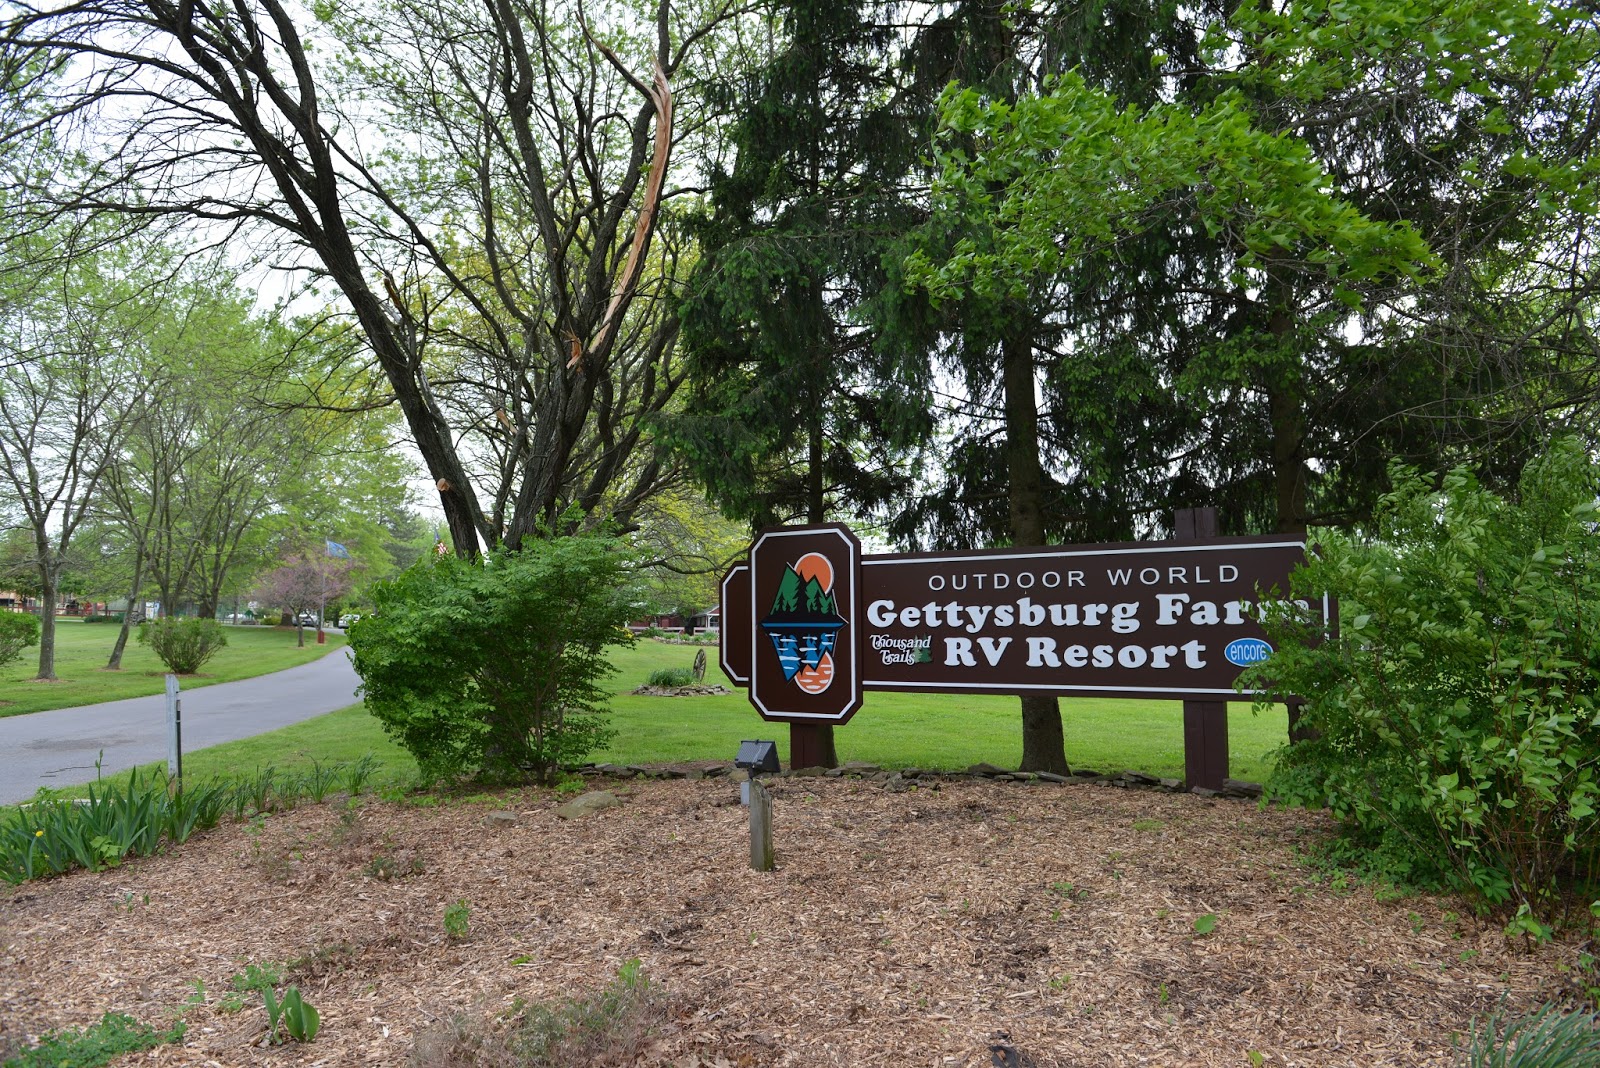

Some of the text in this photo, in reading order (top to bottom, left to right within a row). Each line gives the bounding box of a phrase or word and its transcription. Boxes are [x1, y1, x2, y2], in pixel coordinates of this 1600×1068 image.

[928, 564, 1239, 591] OUTDOOR WORLD
[867, 597, 1141, 634] Gettysburg
[869, 634, 931, 650] Thousand
[943, 636, 1207, 669] RV Resort
[1230, 644, 1268, 661] encore
[880, 650, 915, 666] Trails
